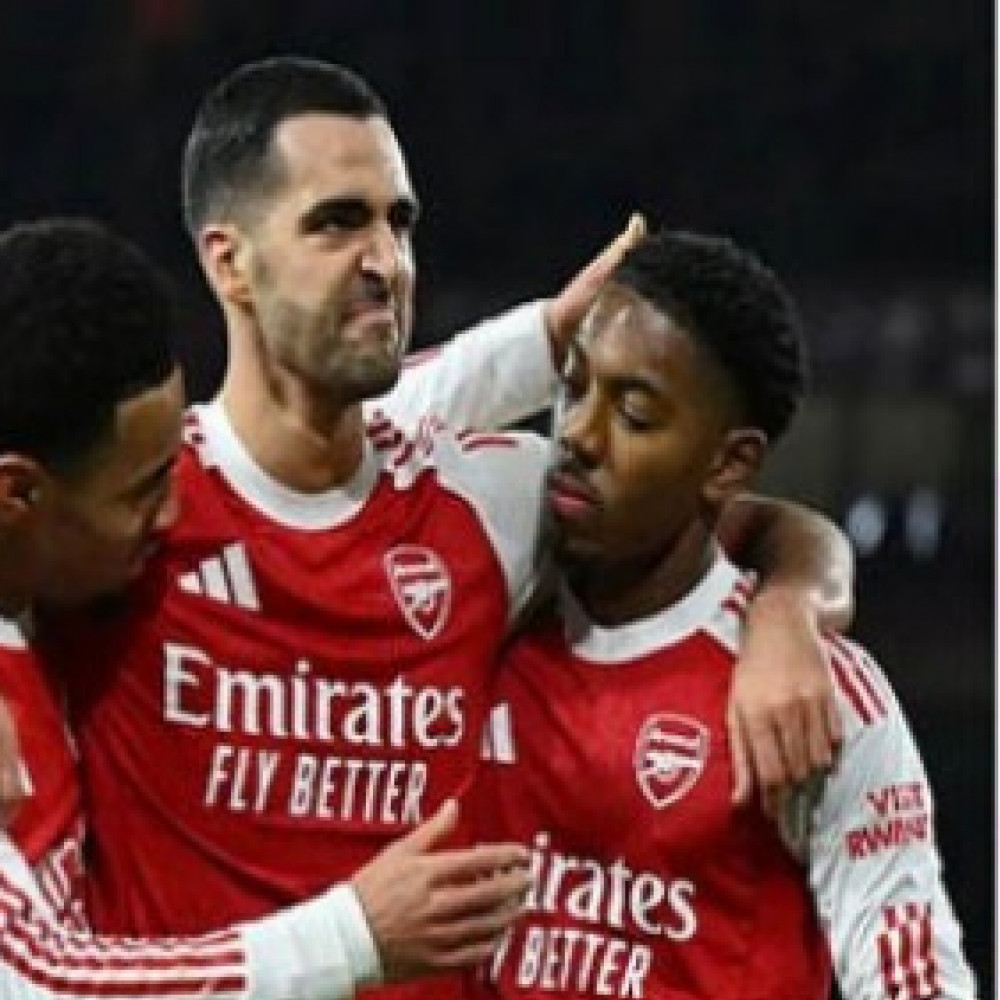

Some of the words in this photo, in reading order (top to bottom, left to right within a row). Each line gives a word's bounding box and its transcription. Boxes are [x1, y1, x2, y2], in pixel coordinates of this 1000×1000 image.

[163, 643, 466, 747] Emirates
[205, 745, 281, 812] FLY
[288, 754, 427, 826] BETTER
[525, 832, 697, 942] irates
[516, 926, 653, 999] BETTER
